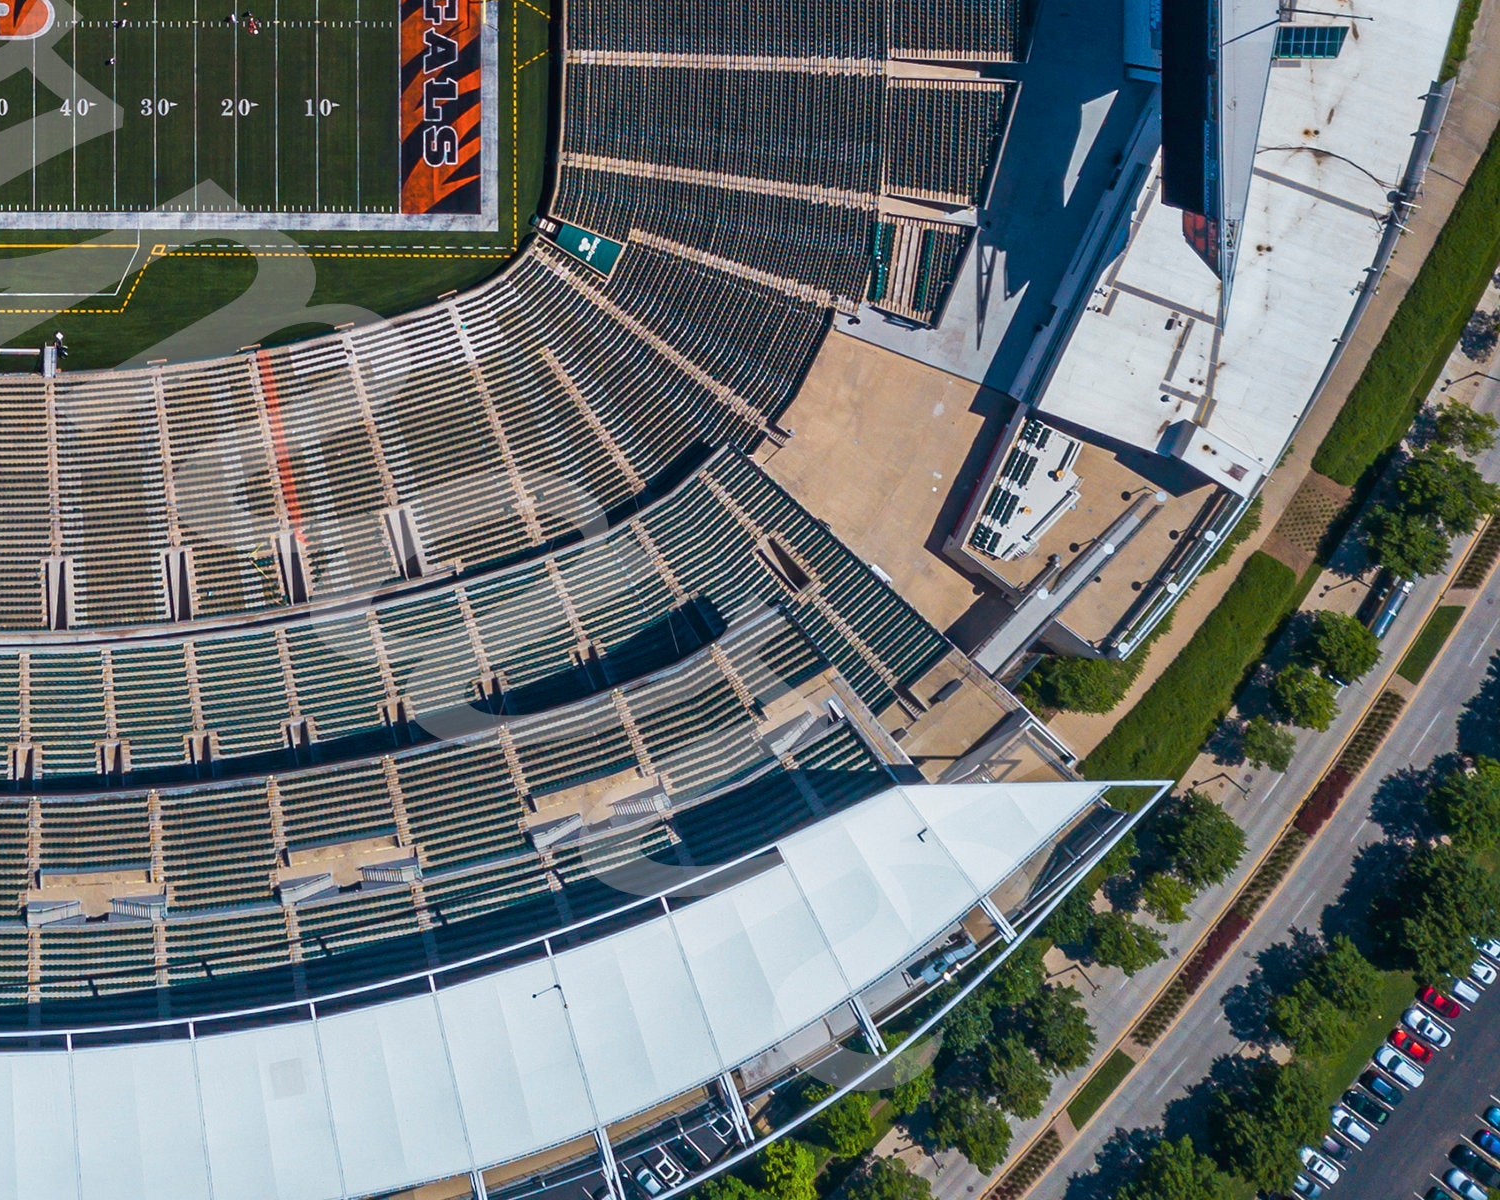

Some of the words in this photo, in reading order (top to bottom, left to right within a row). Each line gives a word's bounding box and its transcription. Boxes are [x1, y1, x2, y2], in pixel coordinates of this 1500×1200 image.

[59, 98, 90, 118] 40
[140, 98, 170, 118] 30
[221, 98, 251, 118] 20
[304, 98, 332, 118] 10
